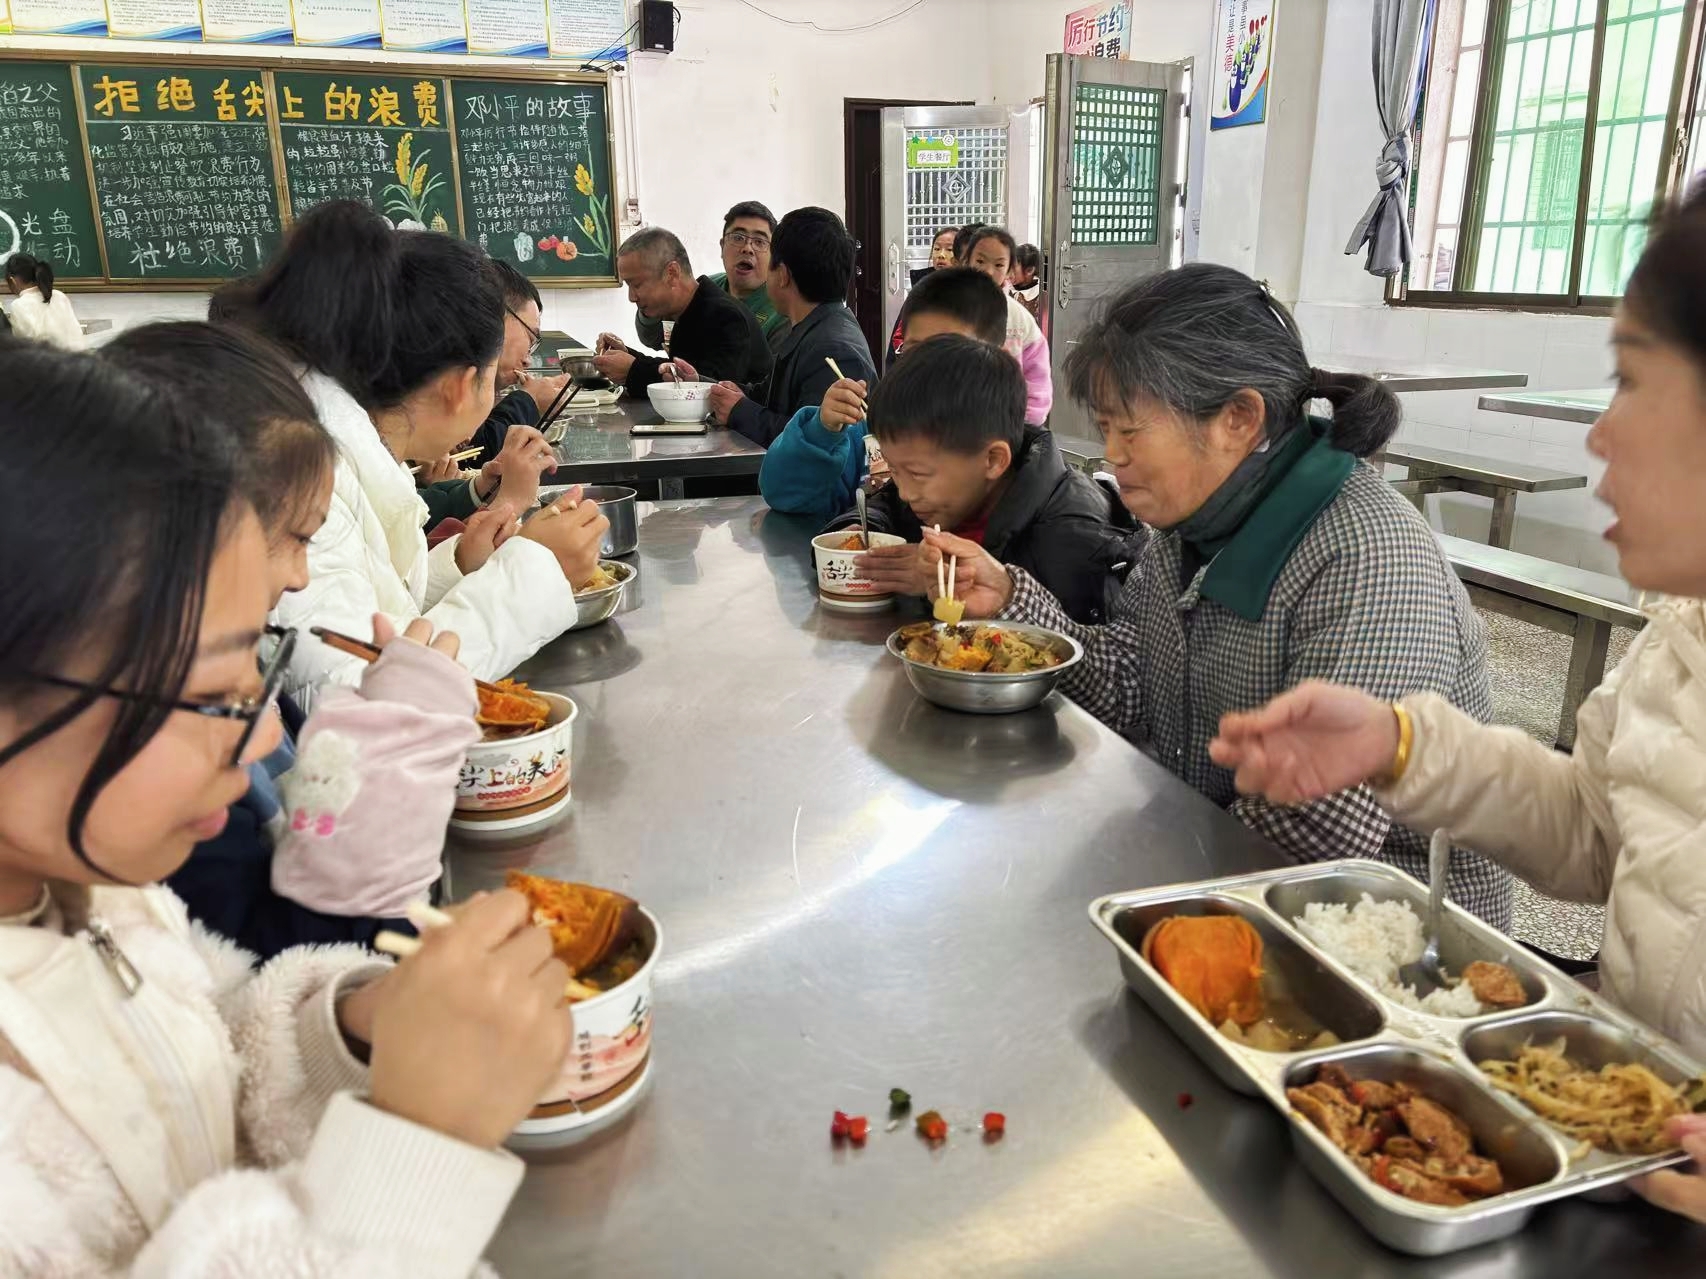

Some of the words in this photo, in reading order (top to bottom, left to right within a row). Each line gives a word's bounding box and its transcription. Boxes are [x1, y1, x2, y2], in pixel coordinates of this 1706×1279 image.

[1068, 3, 1125, 48] 厉行节约
[463, 90, 597, 125] 邓小平的故事
